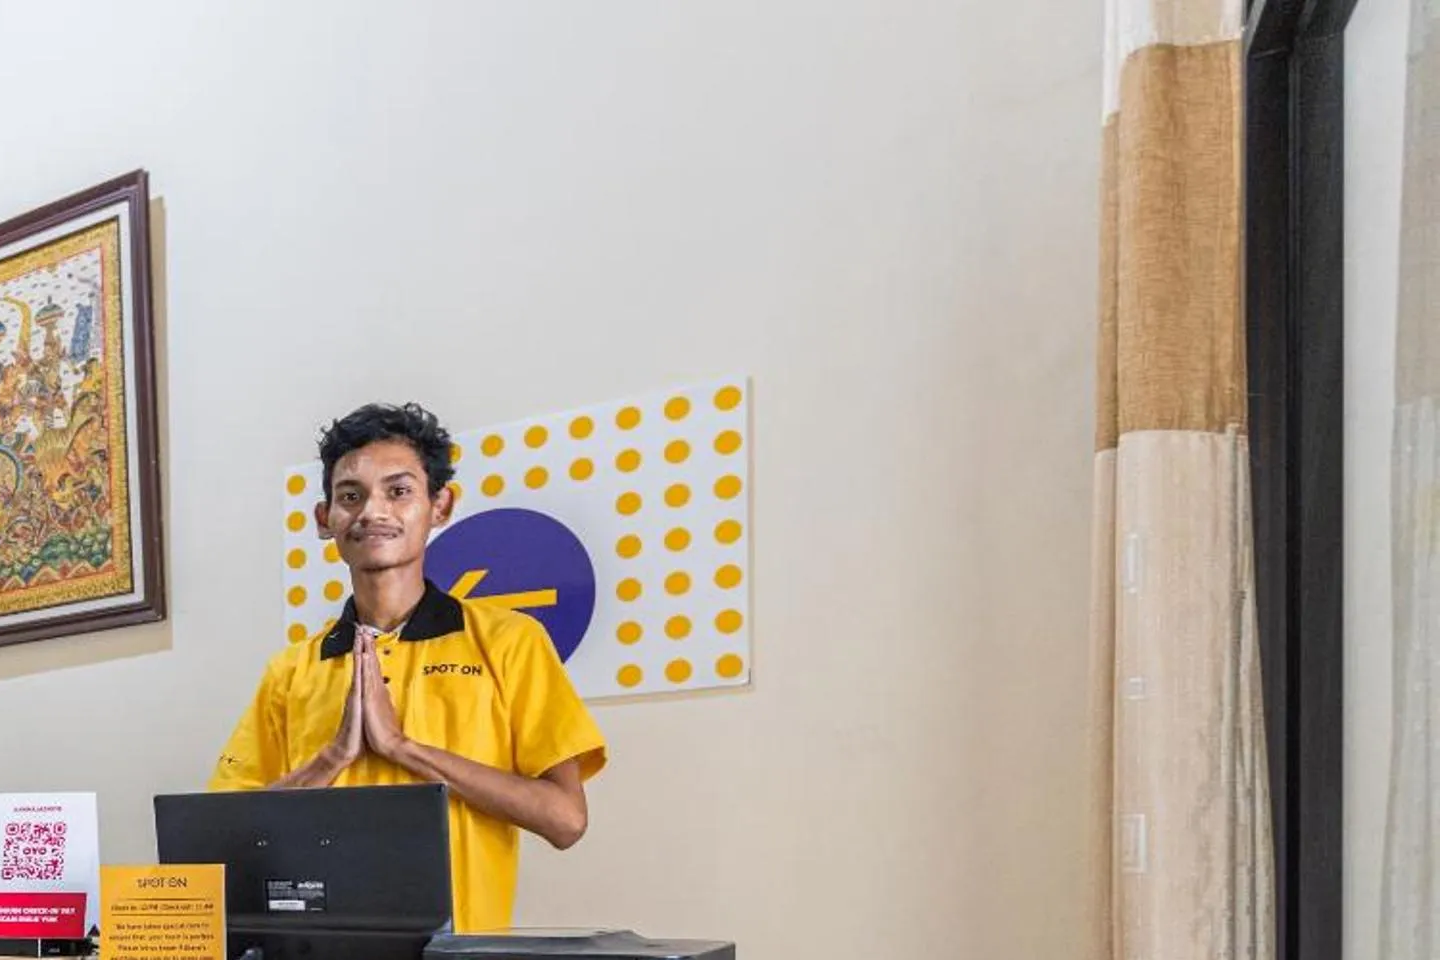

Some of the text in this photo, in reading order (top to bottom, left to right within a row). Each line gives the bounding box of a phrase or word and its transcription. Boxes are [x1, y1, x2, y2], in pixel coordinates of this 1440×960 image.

[423, 663, 482, 676] SPOT ON
[22, 847, 47, 855] OYO
[168, 877, 188, 888] ON
